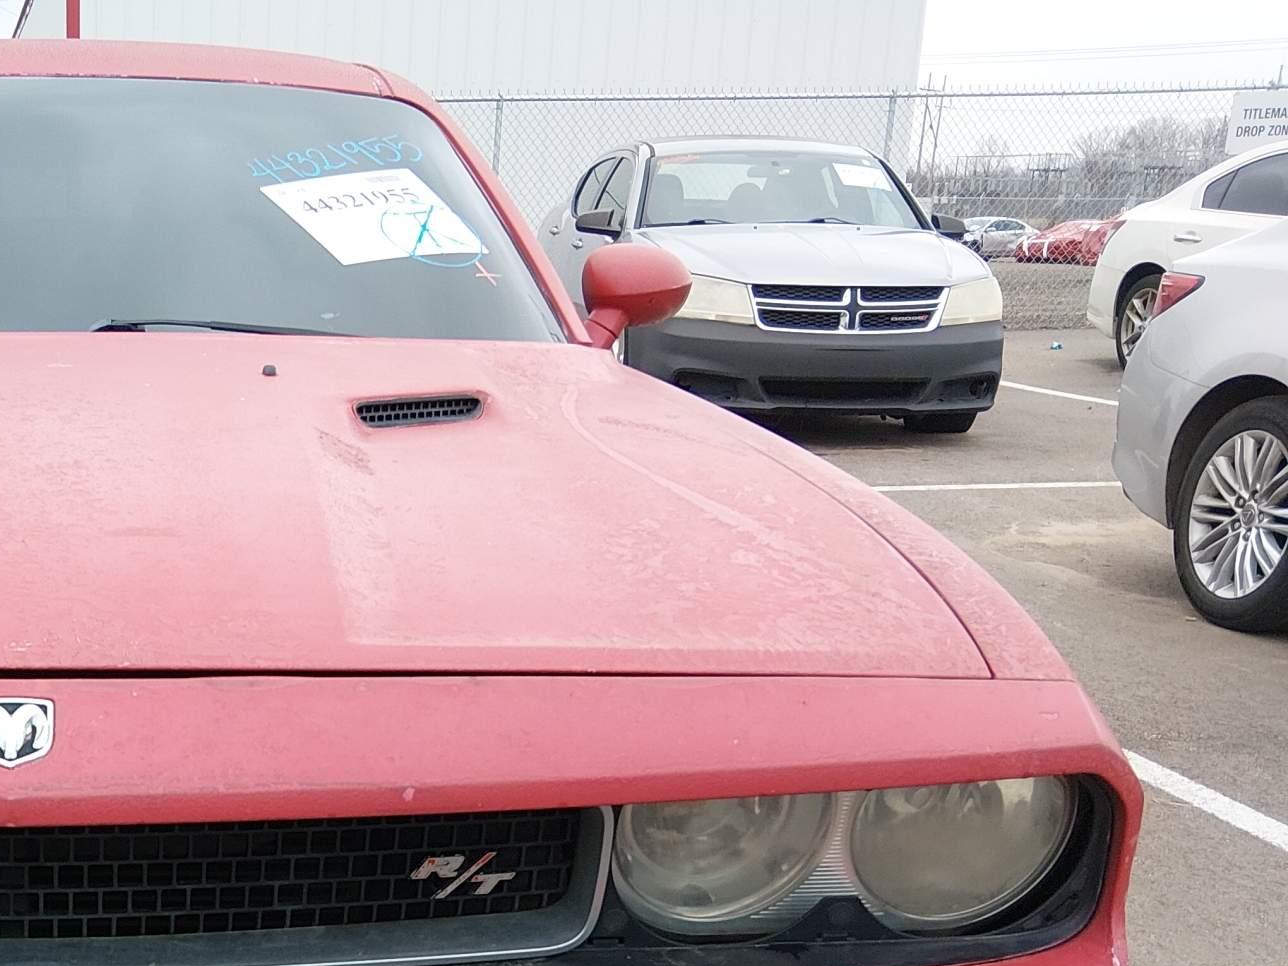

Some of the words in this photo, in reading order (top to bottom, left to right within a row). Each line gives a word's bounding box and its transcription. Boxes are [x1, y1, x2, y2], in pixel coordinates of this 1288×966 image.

[1243, 107, 1288, 120] TITLEMA
[1235, 125, 1265, 137] DROP
[1267, 124, 1288, 136] ZON
[247, 134, 423, 182] 44321955
[302, 187, 420, 213] 44321955
[410, 851, 516, 899] R/T
